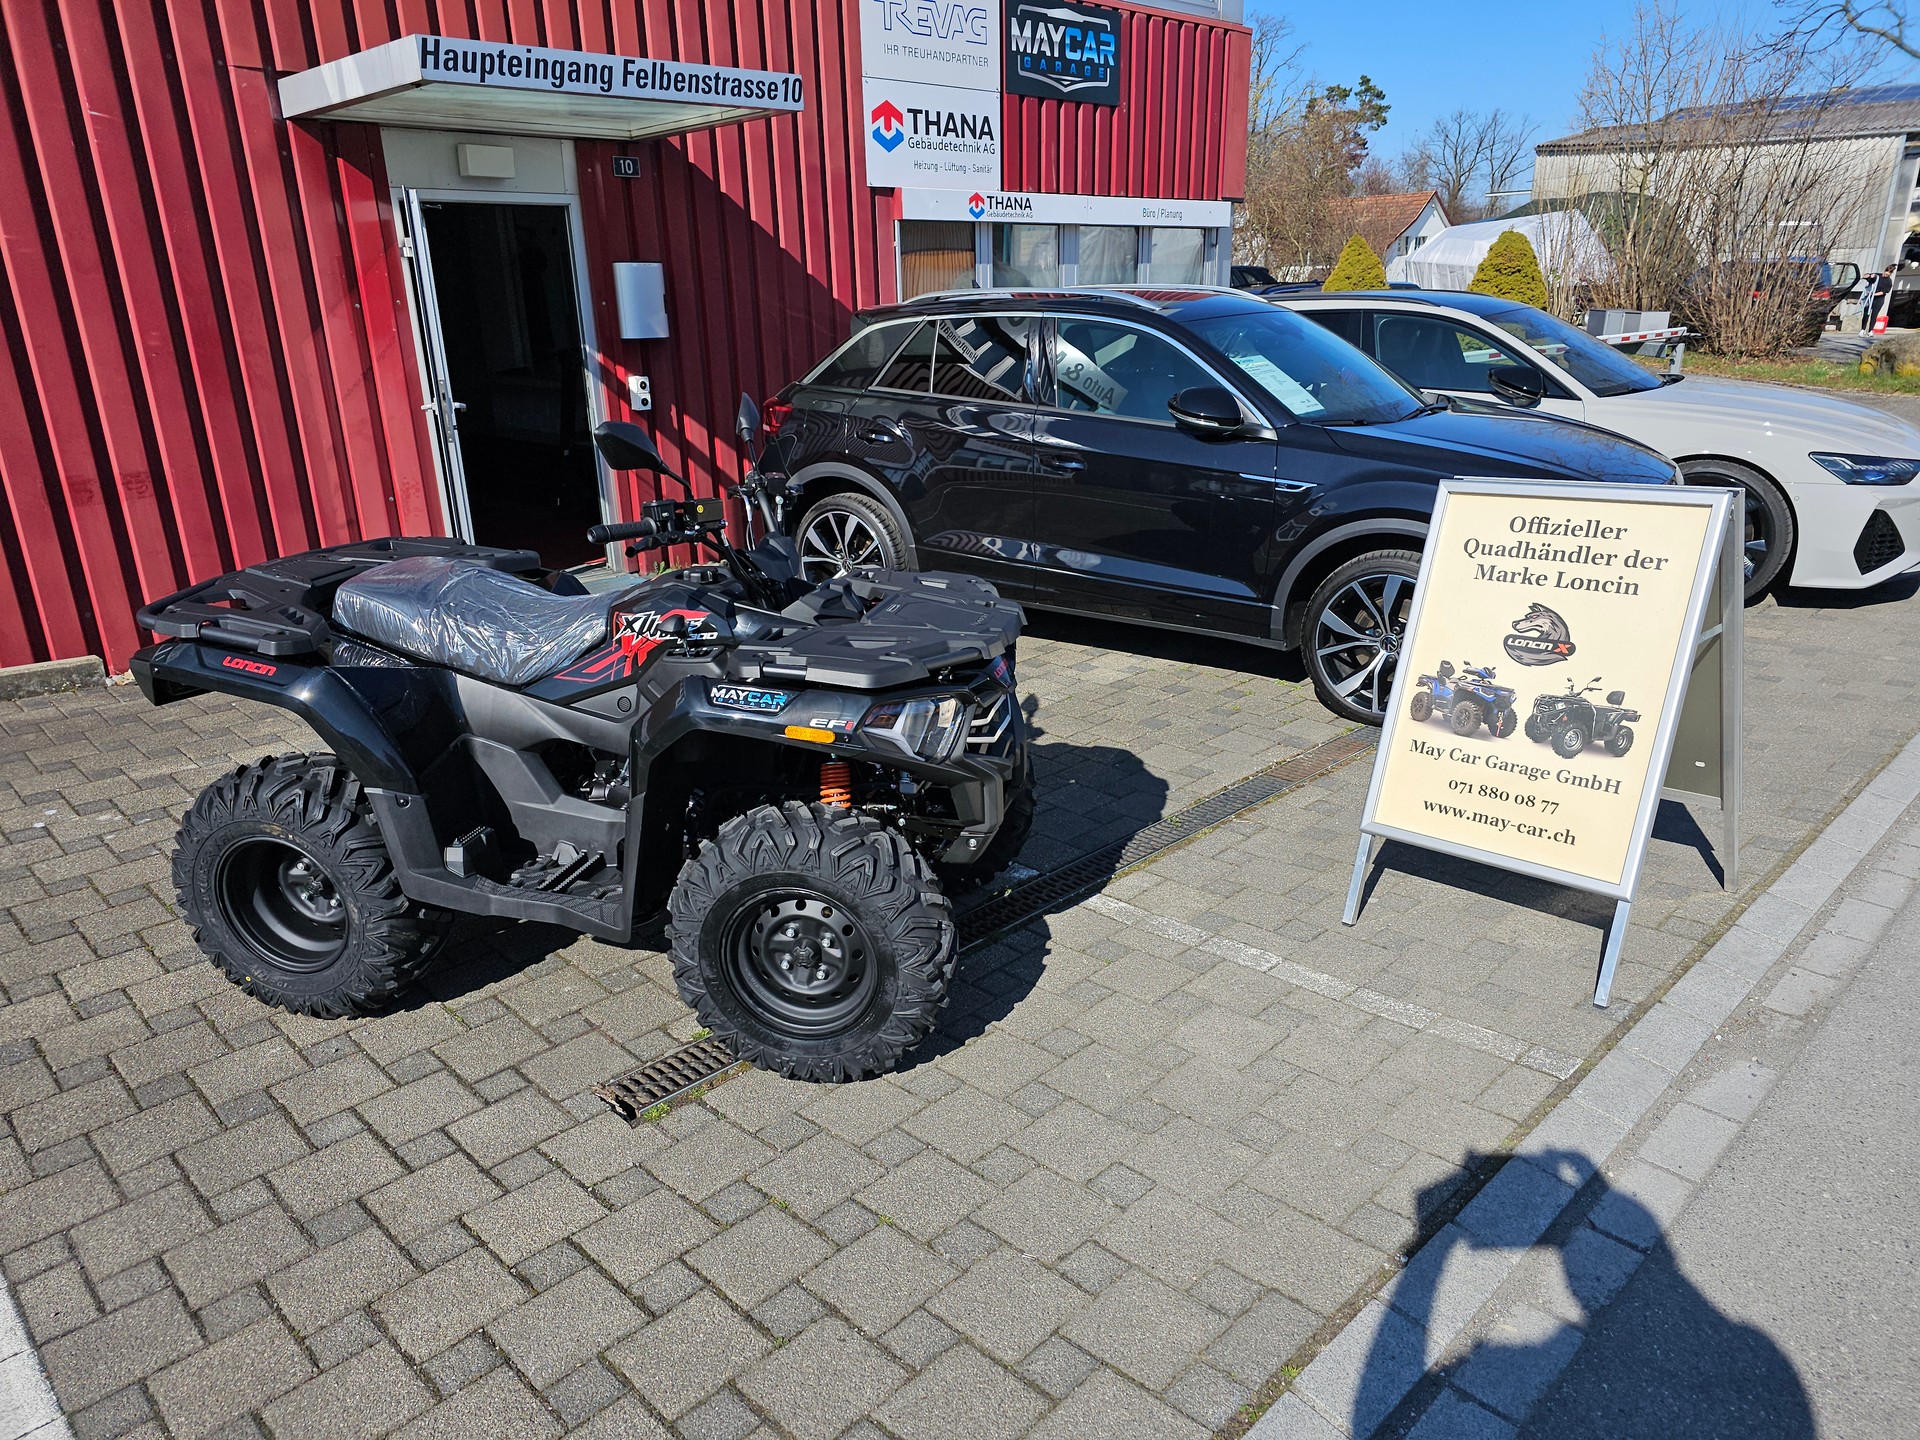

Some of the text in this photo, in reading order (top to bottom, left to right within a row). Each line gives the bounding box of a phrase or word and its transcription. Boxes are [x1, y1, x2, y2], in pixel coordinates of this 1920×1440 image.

[421, 37, 614, 93] Haupteingang
[883, 43, 989, 68] IHR TREUHANDPARTNER
[1024, 56, 1105, 78] GARAGE
[906, 108, 995, 142] THANA
[907, 136, 996, 155] Gebäudetechnik AG
[619, 159, 634, 174] 10
[913, 160, 939, 173] Heizung
[944, 162, 967, 175] Lüftung
[972, 164, 993, 174] Sanitär
[986, 195, 1033, 211] THANA
[1142, 207, 1156, 218] Büro
[1160, 208, 1183, 221] Planung
[1508, 515, 1629, 541] Offizieller
[1463, 537, 1669, 571] Quadhändler der
[1473, 563, 1640, 597] Marke Loncin
[1409, 738, 1623, 796] May Car Garage GmbH
[1448, 779, 1560, 816] 071 880 08 77
[1423, 799, 1577, 847] www.may-car.ch
